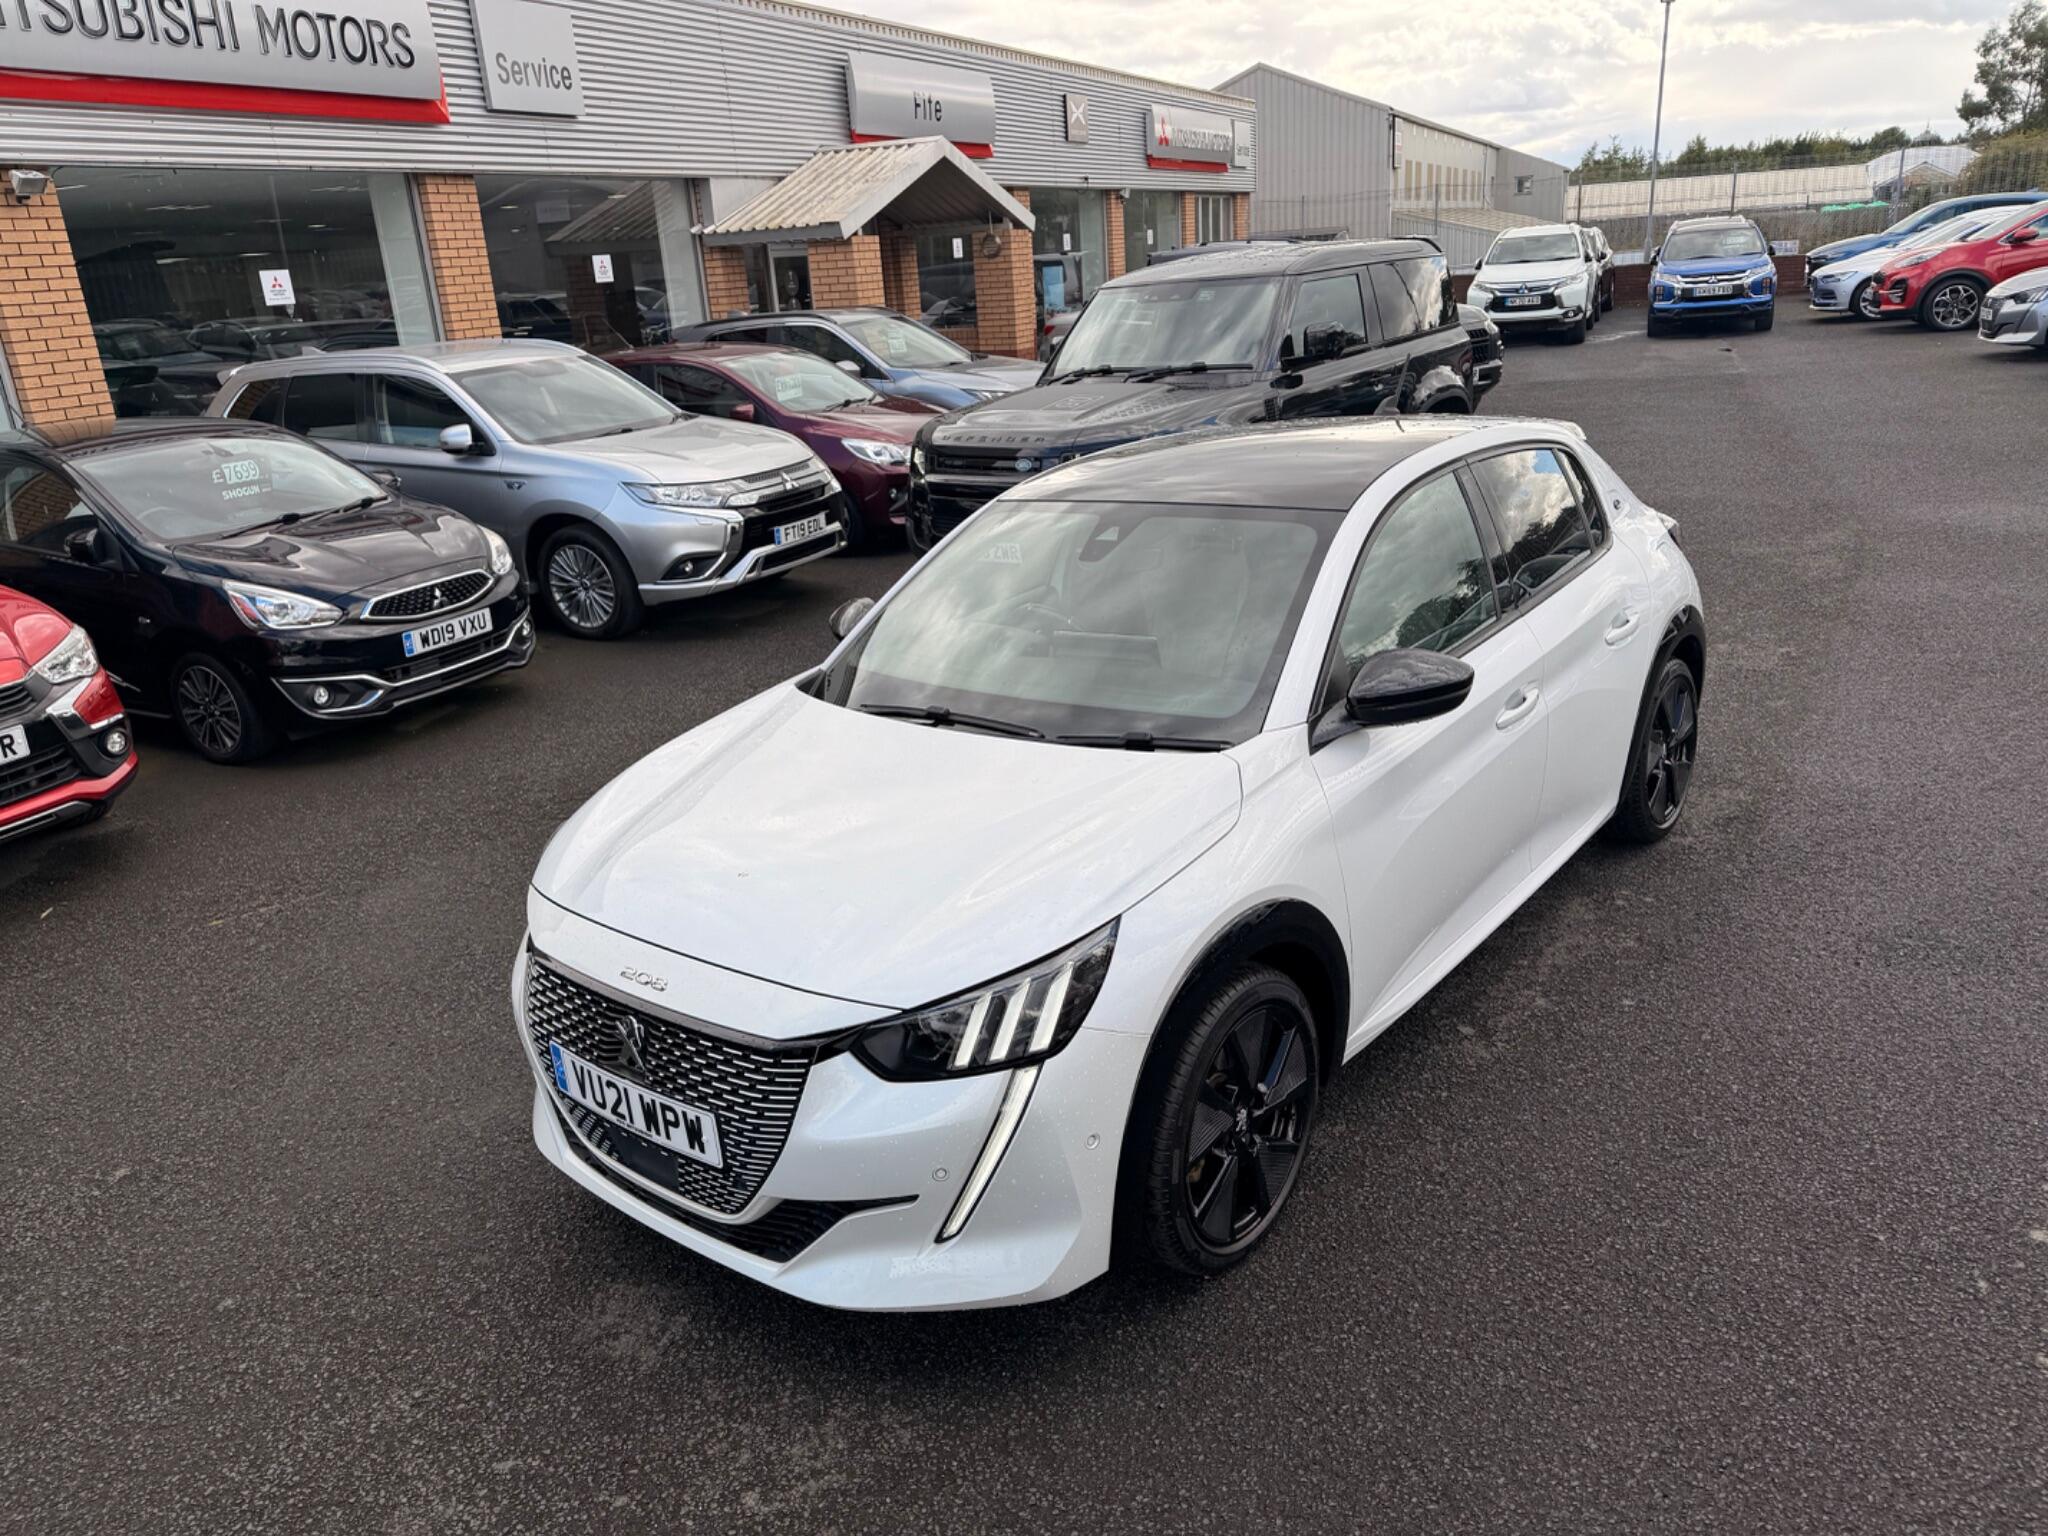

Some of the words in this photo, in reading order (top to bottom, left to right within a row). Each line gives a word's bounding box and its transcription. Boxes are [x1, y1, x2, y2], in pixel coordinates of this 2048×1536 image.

[0, 0, 240, 51] TSUBISHI
[254, 4, 416, 68] MOTORS
[494, 52, 573, 91] Service
[222, 485, 260, 500] SHOGUN
[784, 522, 806, 542] FT19
[419, 623, 455, 649] WD19
[458, 612, 487, 636] VXU
[0, 733, 18, 759] R
[619, 966, 669, 992] 208
[571, 1060, 634, 1125] VU21
[639, 1093, 706, 1155] WPW
